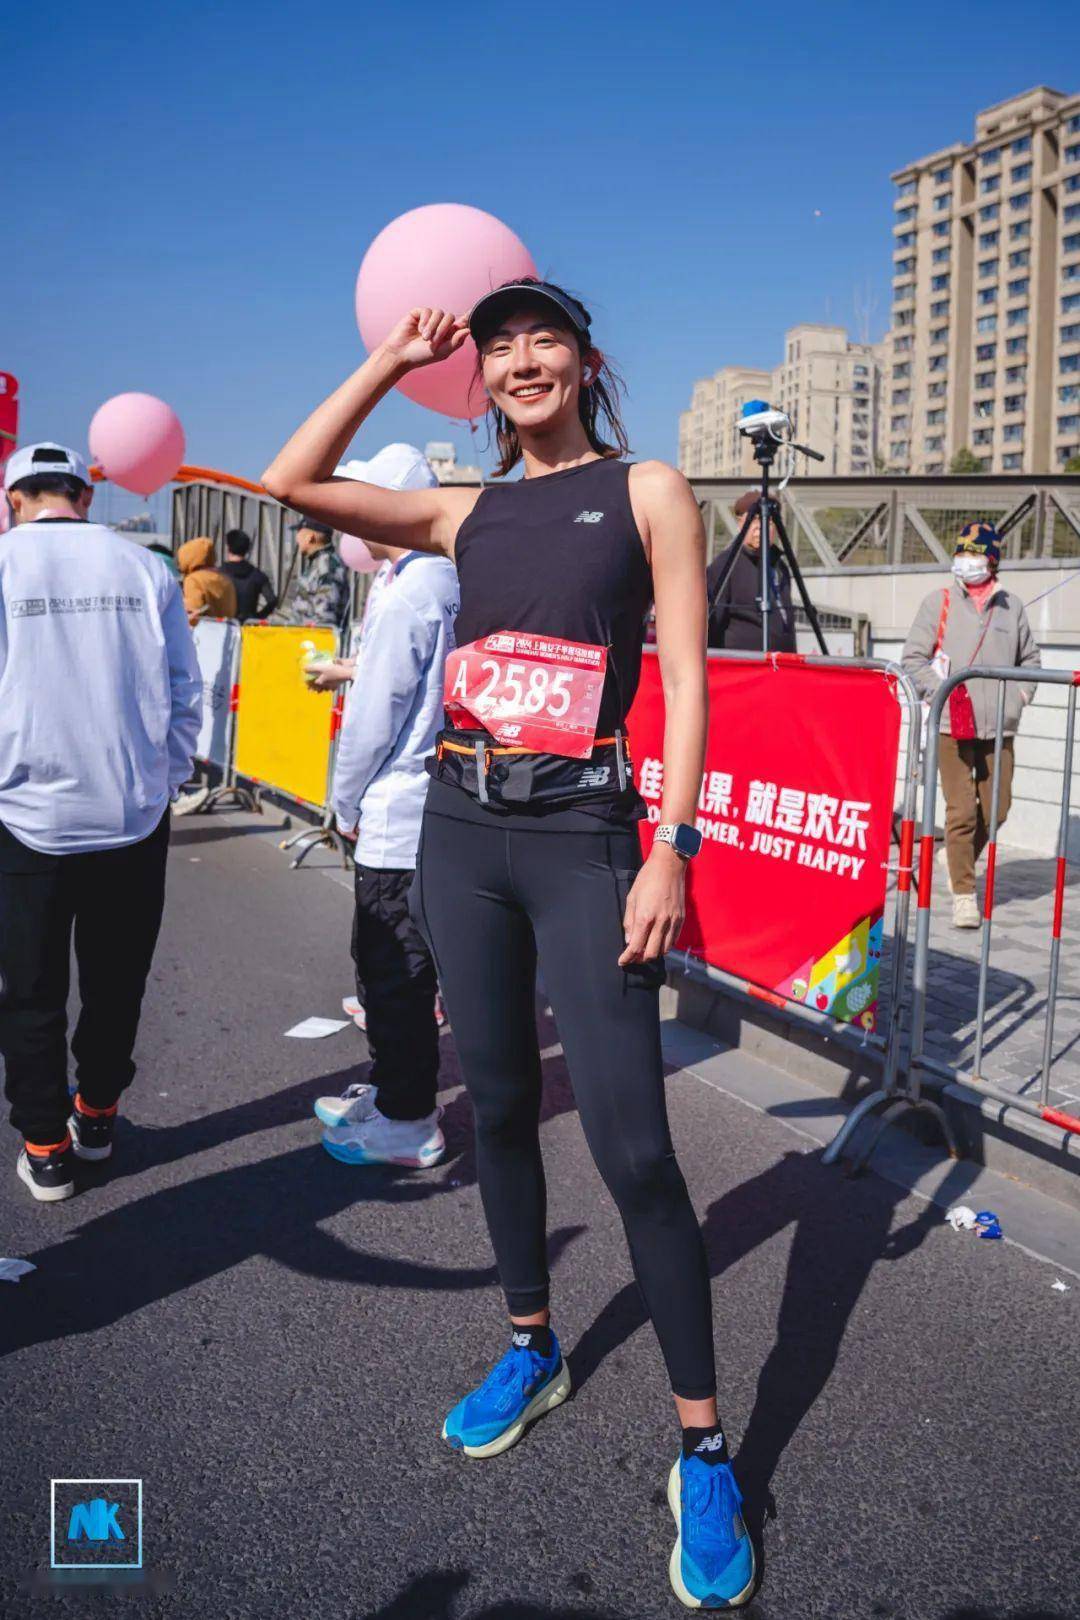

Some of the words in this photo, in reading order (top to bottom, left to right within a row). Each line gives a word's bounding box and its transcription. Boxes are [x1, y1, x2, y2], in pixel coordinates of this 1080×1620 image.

[445, 602, 460, 616] VO
[451, 660, 467, 698] A
[475, 660, 574, 717] 2585
[577, 766, 611, 788] NB
[749, 831, 796, 861] JUST
[797, 842, 866, 880] HAPPY
